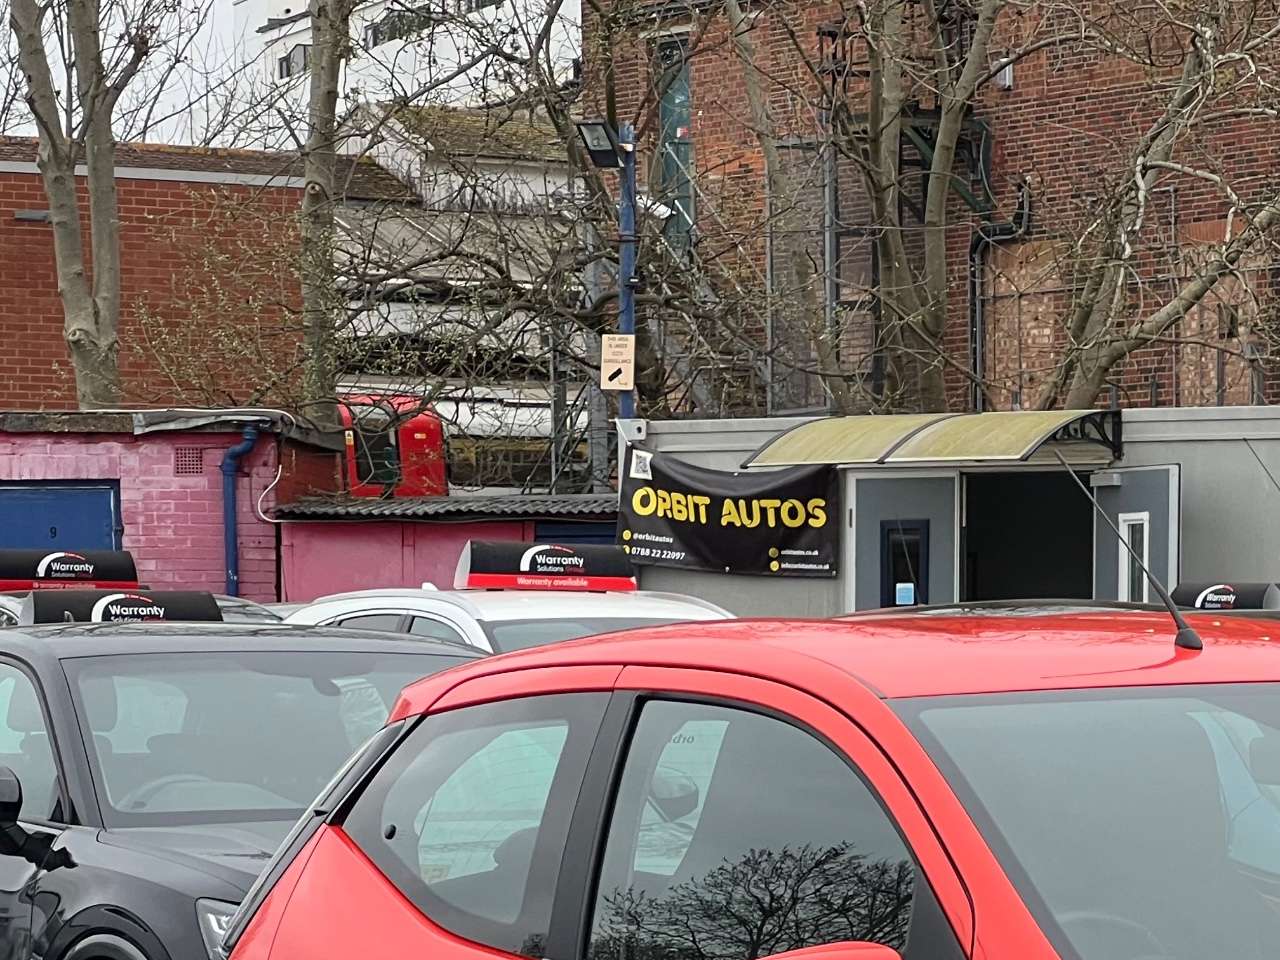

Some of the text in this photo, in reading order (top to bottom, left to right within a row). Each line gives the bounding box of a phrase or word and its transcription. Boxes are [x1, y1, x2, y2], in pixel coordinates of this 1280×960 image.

[632, 486, 828, 529] ORBIT AUTOS
[50, 526, 57, 538] 9
[536, 554, 584, 568] Warranty
[51, 562, 94, 574] Warranty
[517, 577, 589, 587] Warranty available
[1206, 593, 1236, 604] Warranty
[109, 604, 165, 618] Warranty
